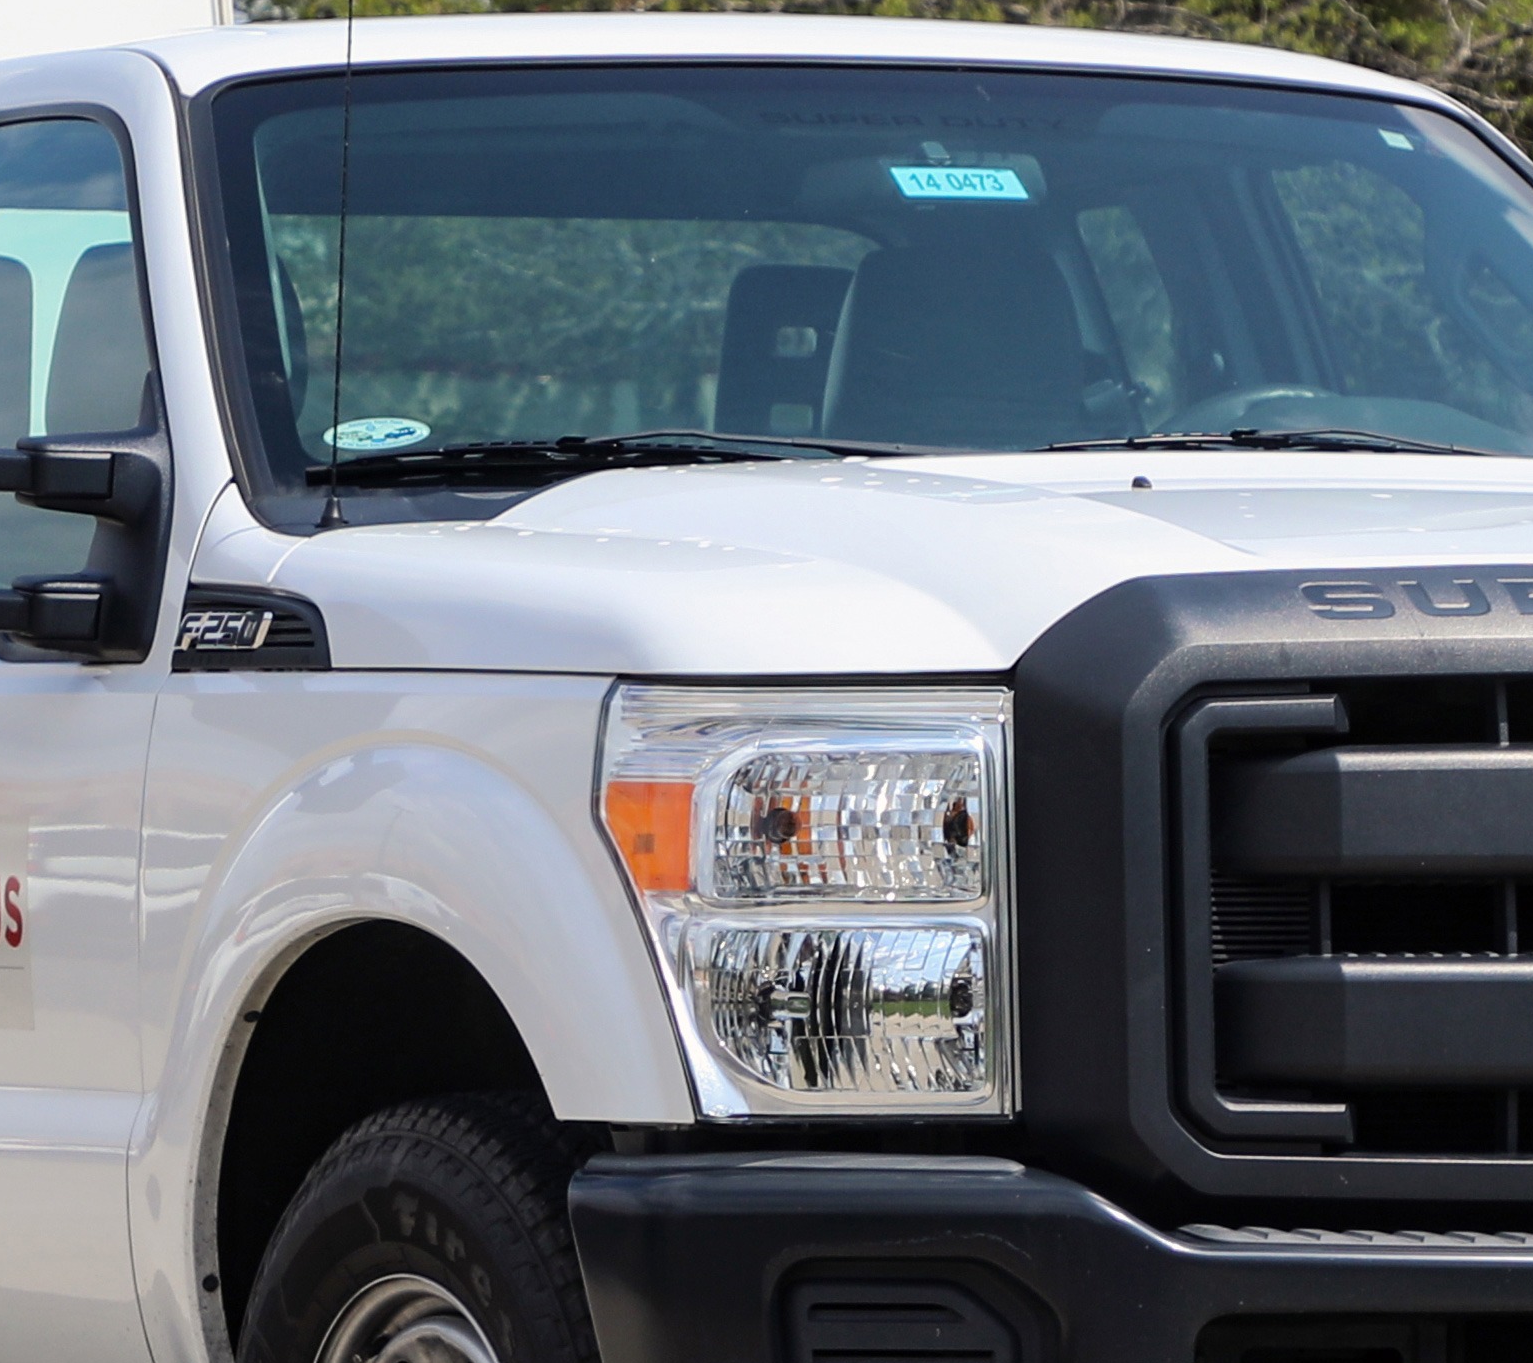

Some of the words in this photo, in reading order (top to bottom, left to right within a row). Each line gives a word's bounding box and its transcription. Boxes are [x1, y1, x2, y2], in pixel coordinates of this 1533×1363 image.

[908, 173, 941, 191] 14
[946, 173, 1004, 192] 0473
[175, 611, 273, 651] F-250
